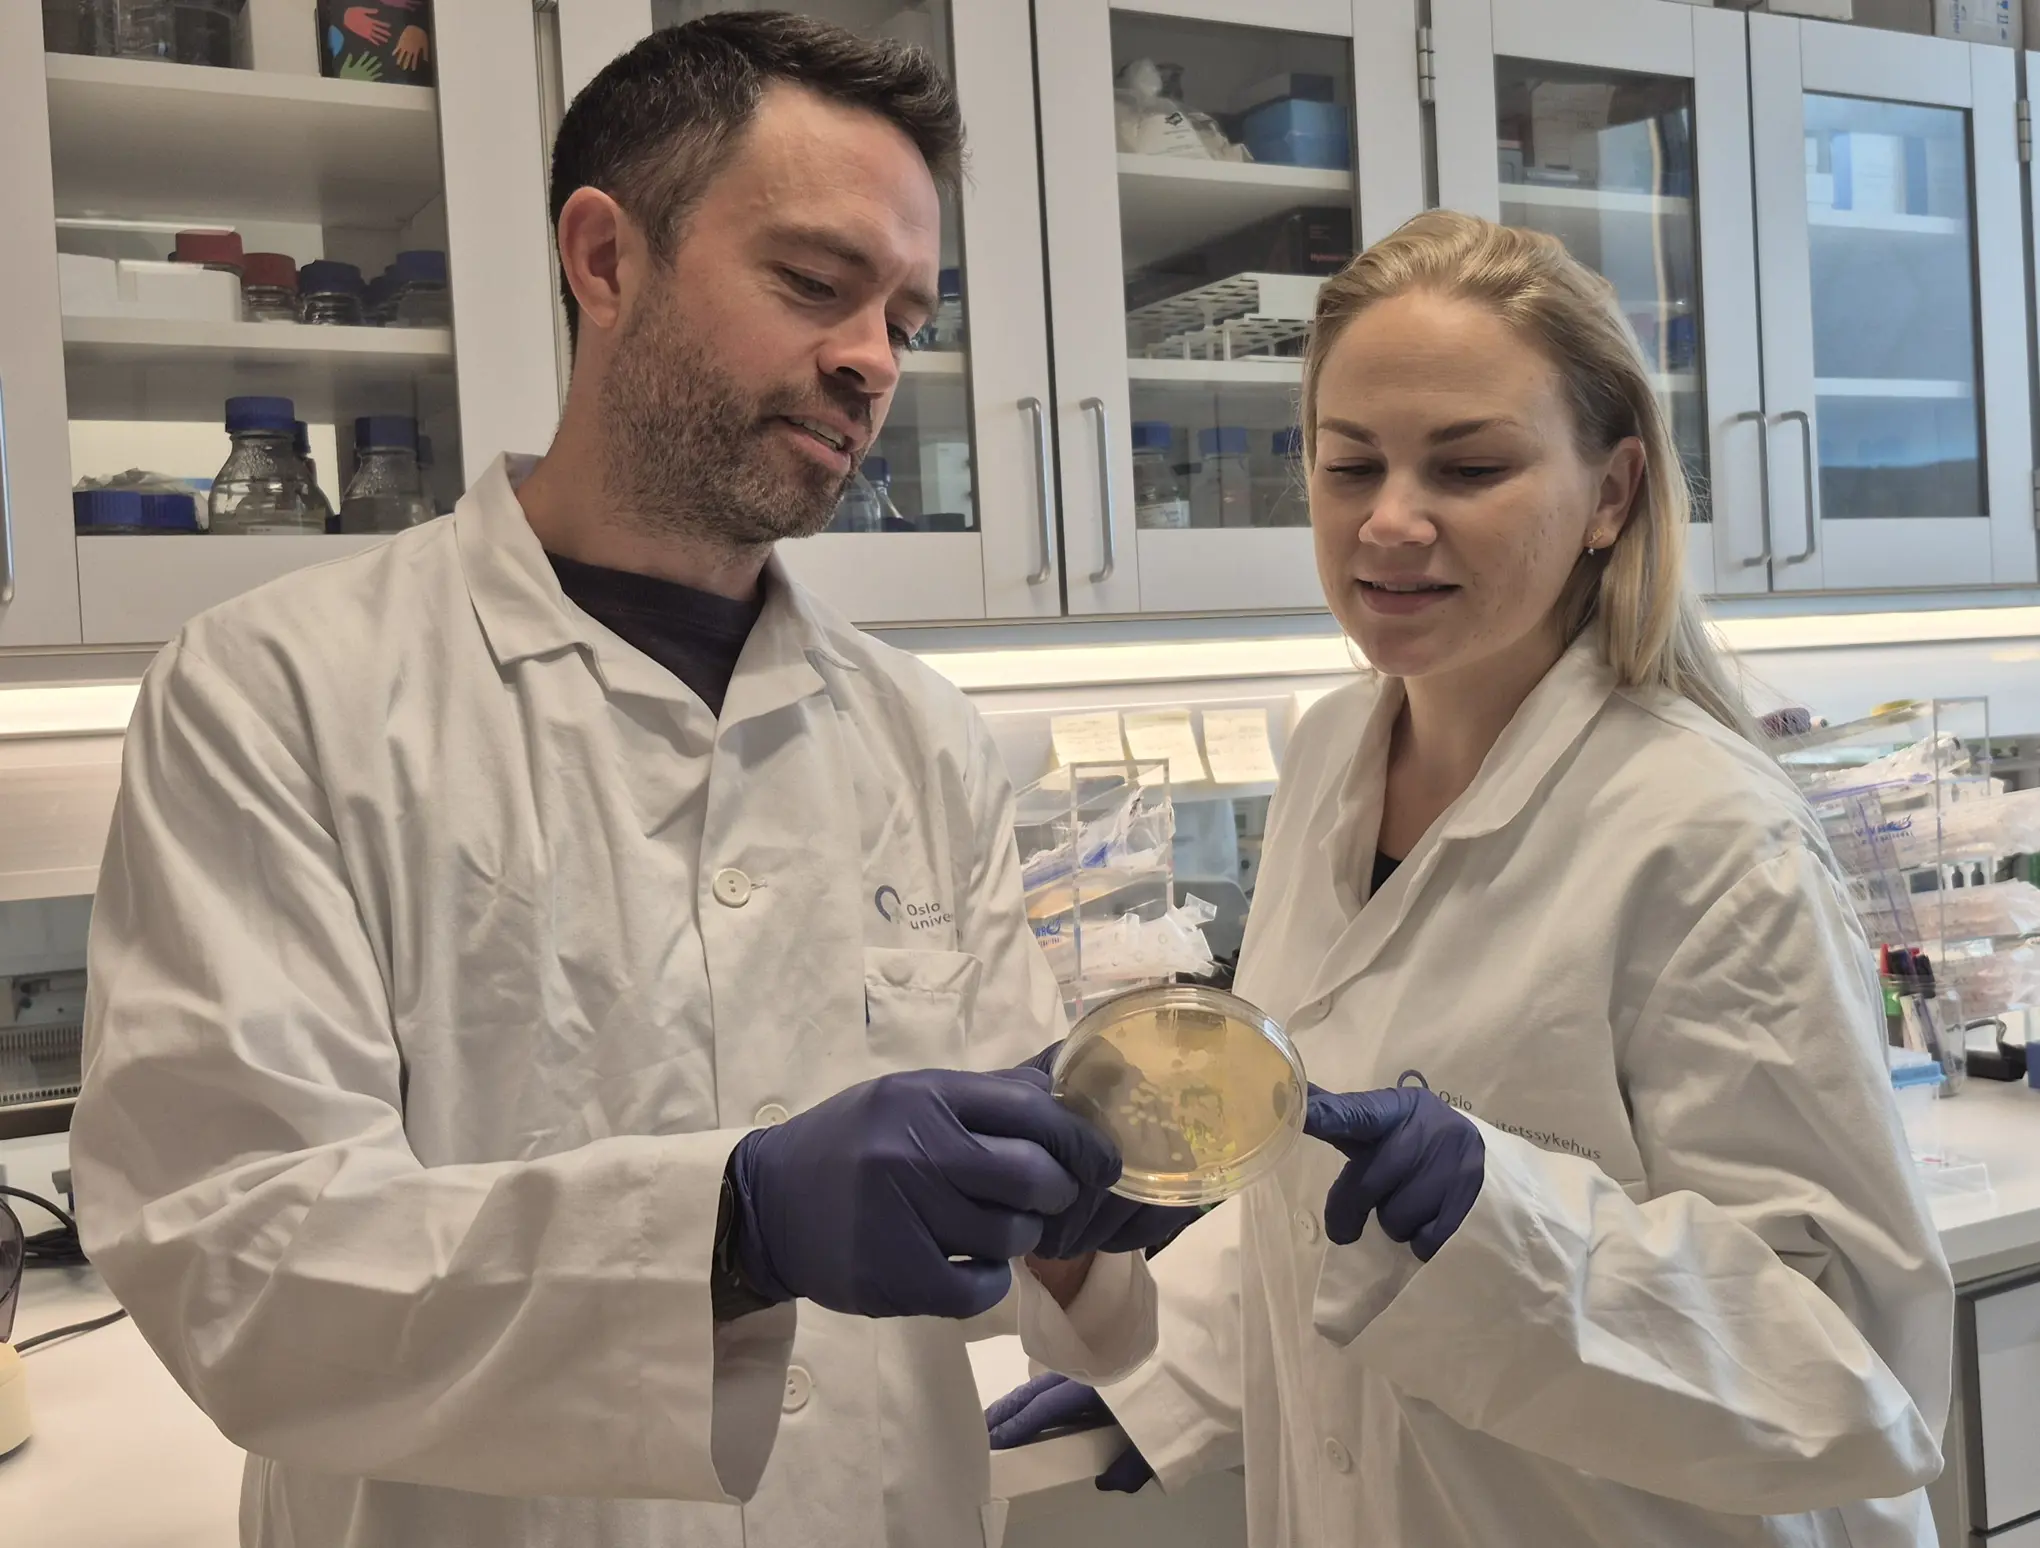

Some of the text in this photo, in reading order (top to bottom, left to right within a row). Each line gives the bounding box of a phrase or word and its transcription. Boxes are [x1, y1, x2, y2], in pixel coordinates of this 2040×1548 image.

[906, 902, 941, 916] Oslo
[910, 913, 953, 930] unive
[1439, 1090, 1472, 1111] Oslo
[1489, 1119, 1602, 1160] itetssykehus
